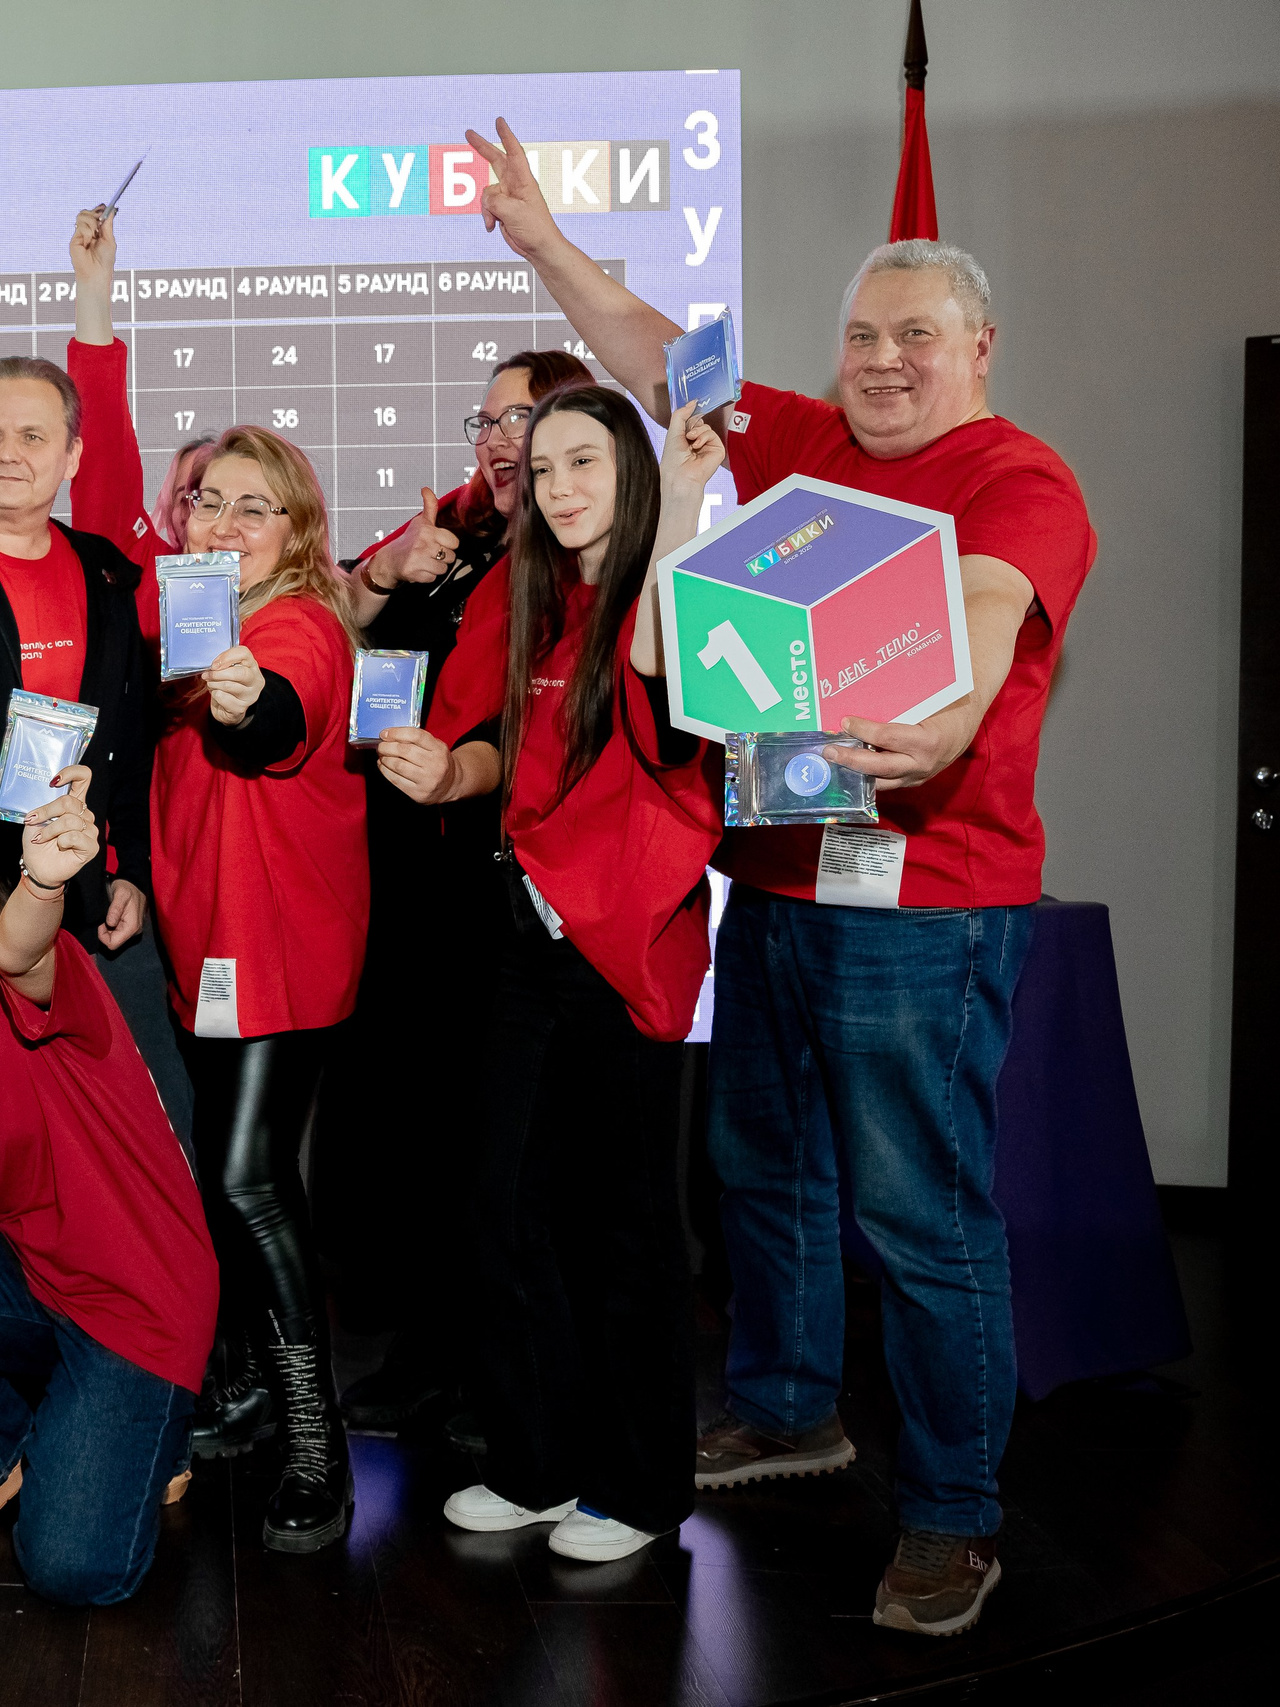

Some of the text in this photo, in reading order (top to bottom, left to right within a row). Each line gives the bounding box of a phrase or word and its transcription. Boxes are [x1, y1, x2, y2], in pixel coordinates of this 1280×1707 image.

[321, 148, 660, 210] КУБКИ
[39, 282, 52, 302] 2
[138, 276, 228, 301] 3 РАУНД
[236, 274, 329, 298] 4 РАУНД
[337, 272, 429, 295] 5 РАУНД
[438, 270, 530, 294] 6 РАУНД
[173, 347, 195, 368] 17
[271, 345, 298, 366] 24
[374, 343, 396, 364] 17
[471, 341, 499, 362] 42
[174, 410, 196, 431] 17
[272, 408, 299, 429] 36
[373, 406, 397, 427] 16
[375, 467, 394, 488] 11
[749, 514, 835, 574] КУБИКИ
[783, 543, 813, 565] since 2025
[906, 632, 943, 658] команда
[696, 619, 783, 713] 1
[837, 658, 870, 690] ДЕЛЕ
